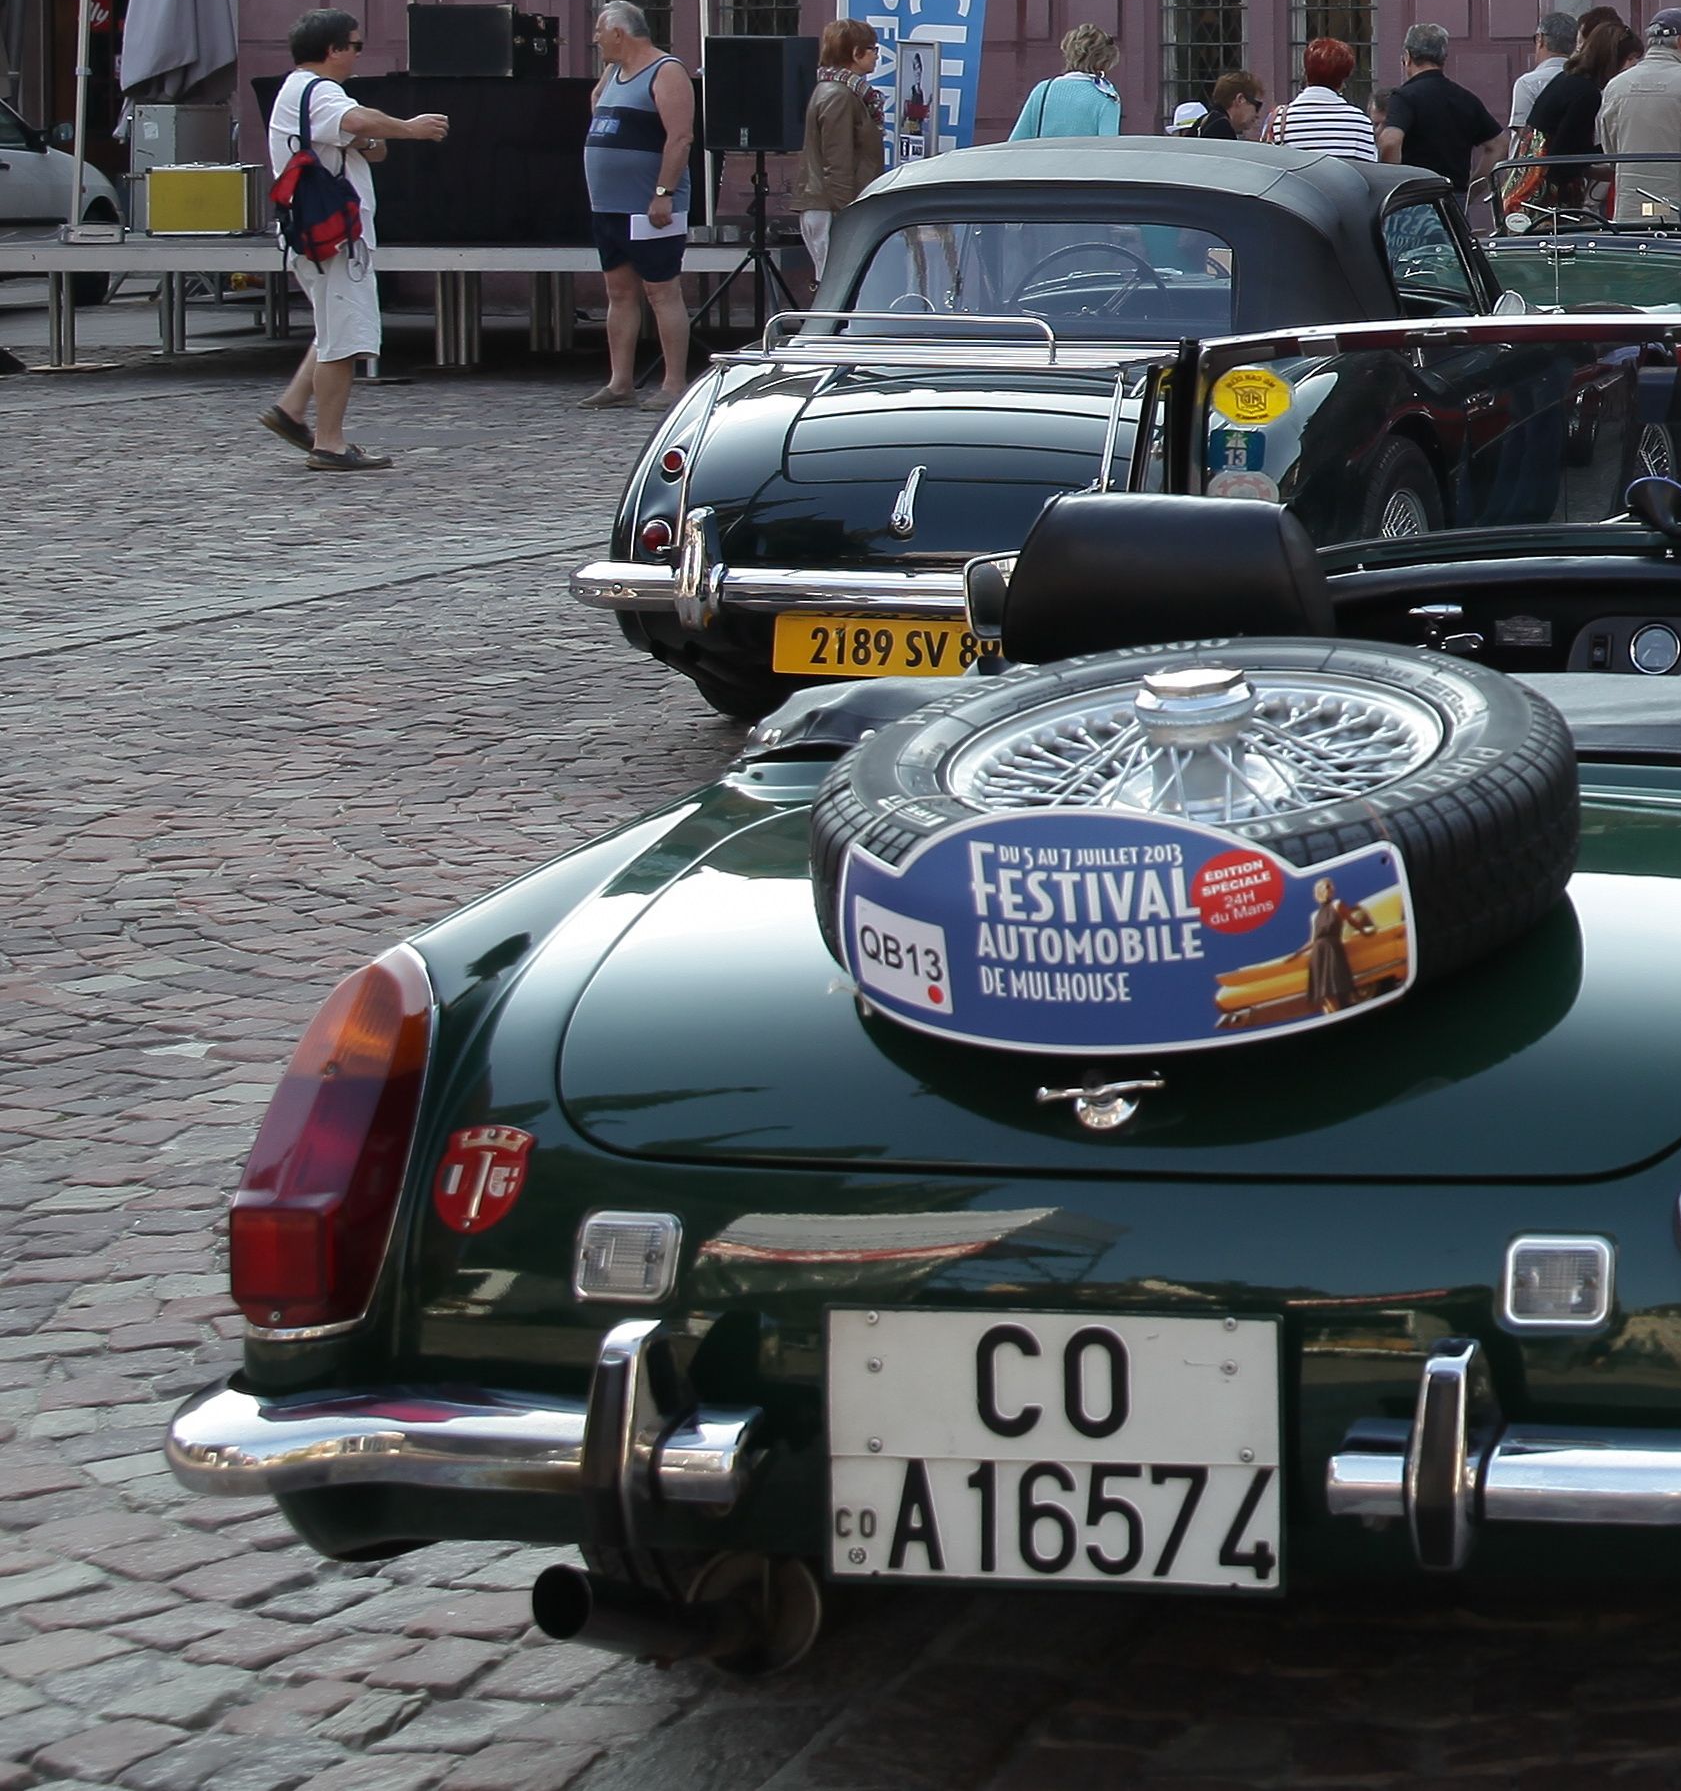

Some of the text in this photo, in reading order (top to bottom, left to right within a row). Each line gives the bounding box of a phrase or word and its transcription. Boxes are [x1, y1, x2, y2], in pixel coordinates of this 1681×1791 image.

[1225, 449, 1247, 466] 13
[810, 626, 894, 666] 2189
[905, 630, 949, 668] SV
[1000, 843, 1183, 871] DU 5 AU 7 JUILLET 2013
[1204, 859, 1265, 883] EDITION
[969, 840, 1201, 923] FESTIVAL
[1223, 891, 1256, 910] 24H
[1210, 900, 1275, 925] du Mans
[860, 924, 944, 982] QB13
[978, 921, 1205, 965] AUTOMOBILE
[980, 965, 1132, 1002] DE MULHOUSE
[976, 1322, 1132, 1439] CO
[835, 1457, 1277, 1580] CO A16574
